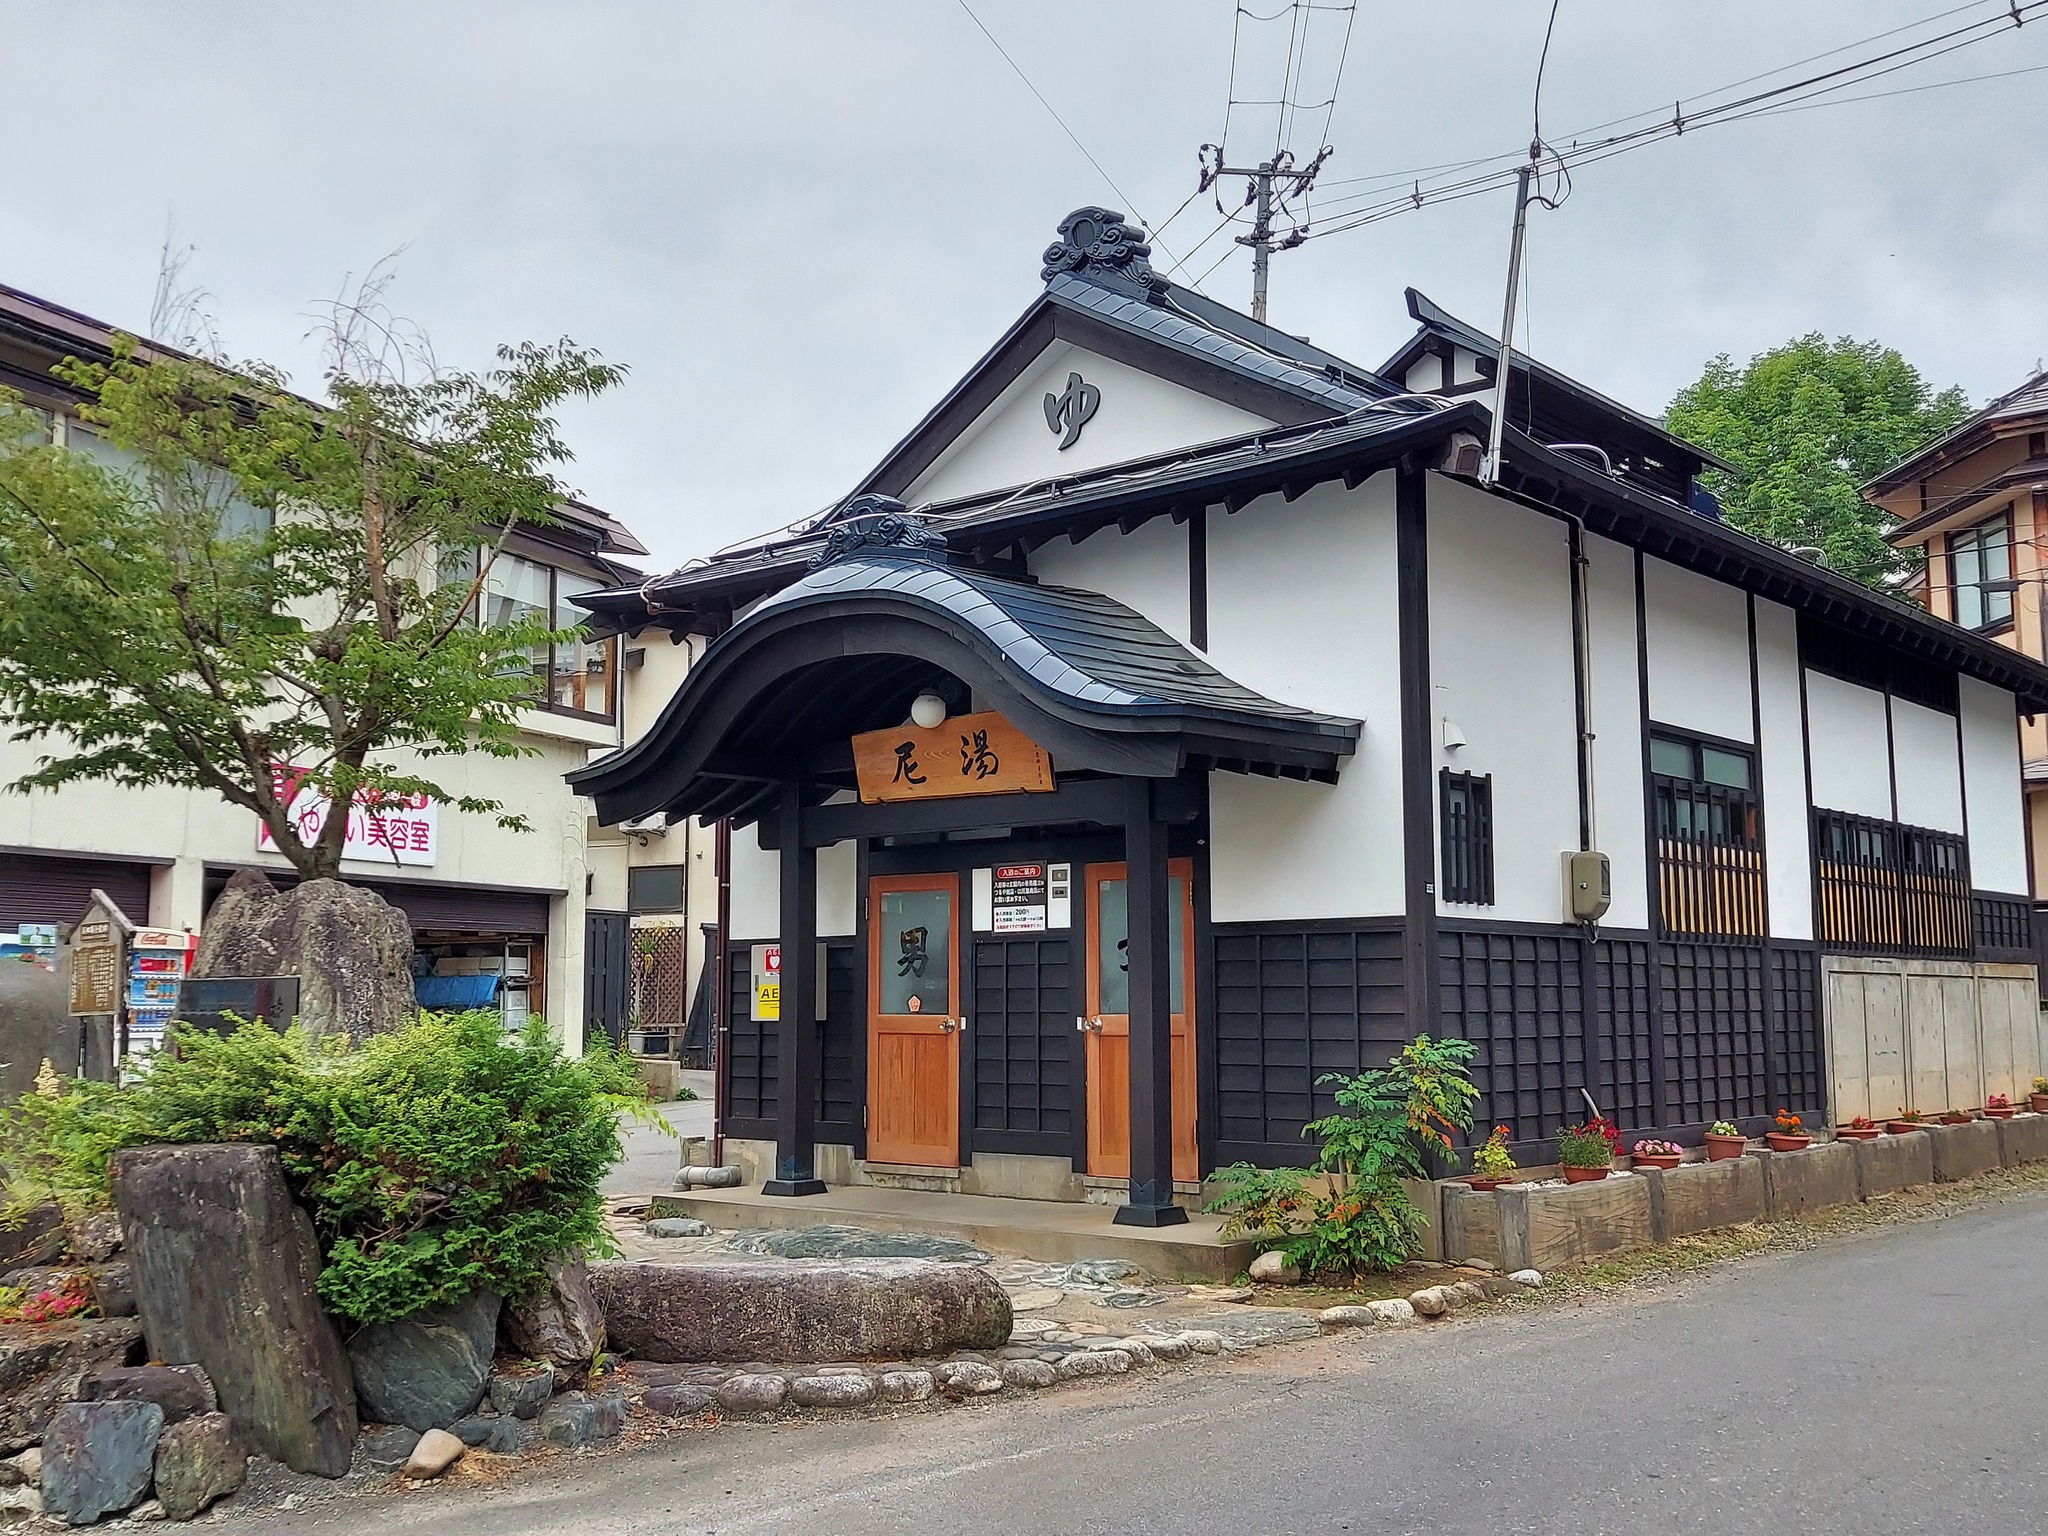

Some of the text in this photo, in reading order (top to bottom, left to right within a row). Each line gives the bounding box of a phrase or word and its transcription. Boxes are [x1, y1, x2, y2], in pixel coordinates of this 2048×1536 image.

[1043, 372, 1101, 451] ゆ
[891, 728, 1000, 785] 尼湯
[300, 808, 431, 852] やい美容室
[896, 926, 929, 979] 男
[761, 988, 779, 999] AE
